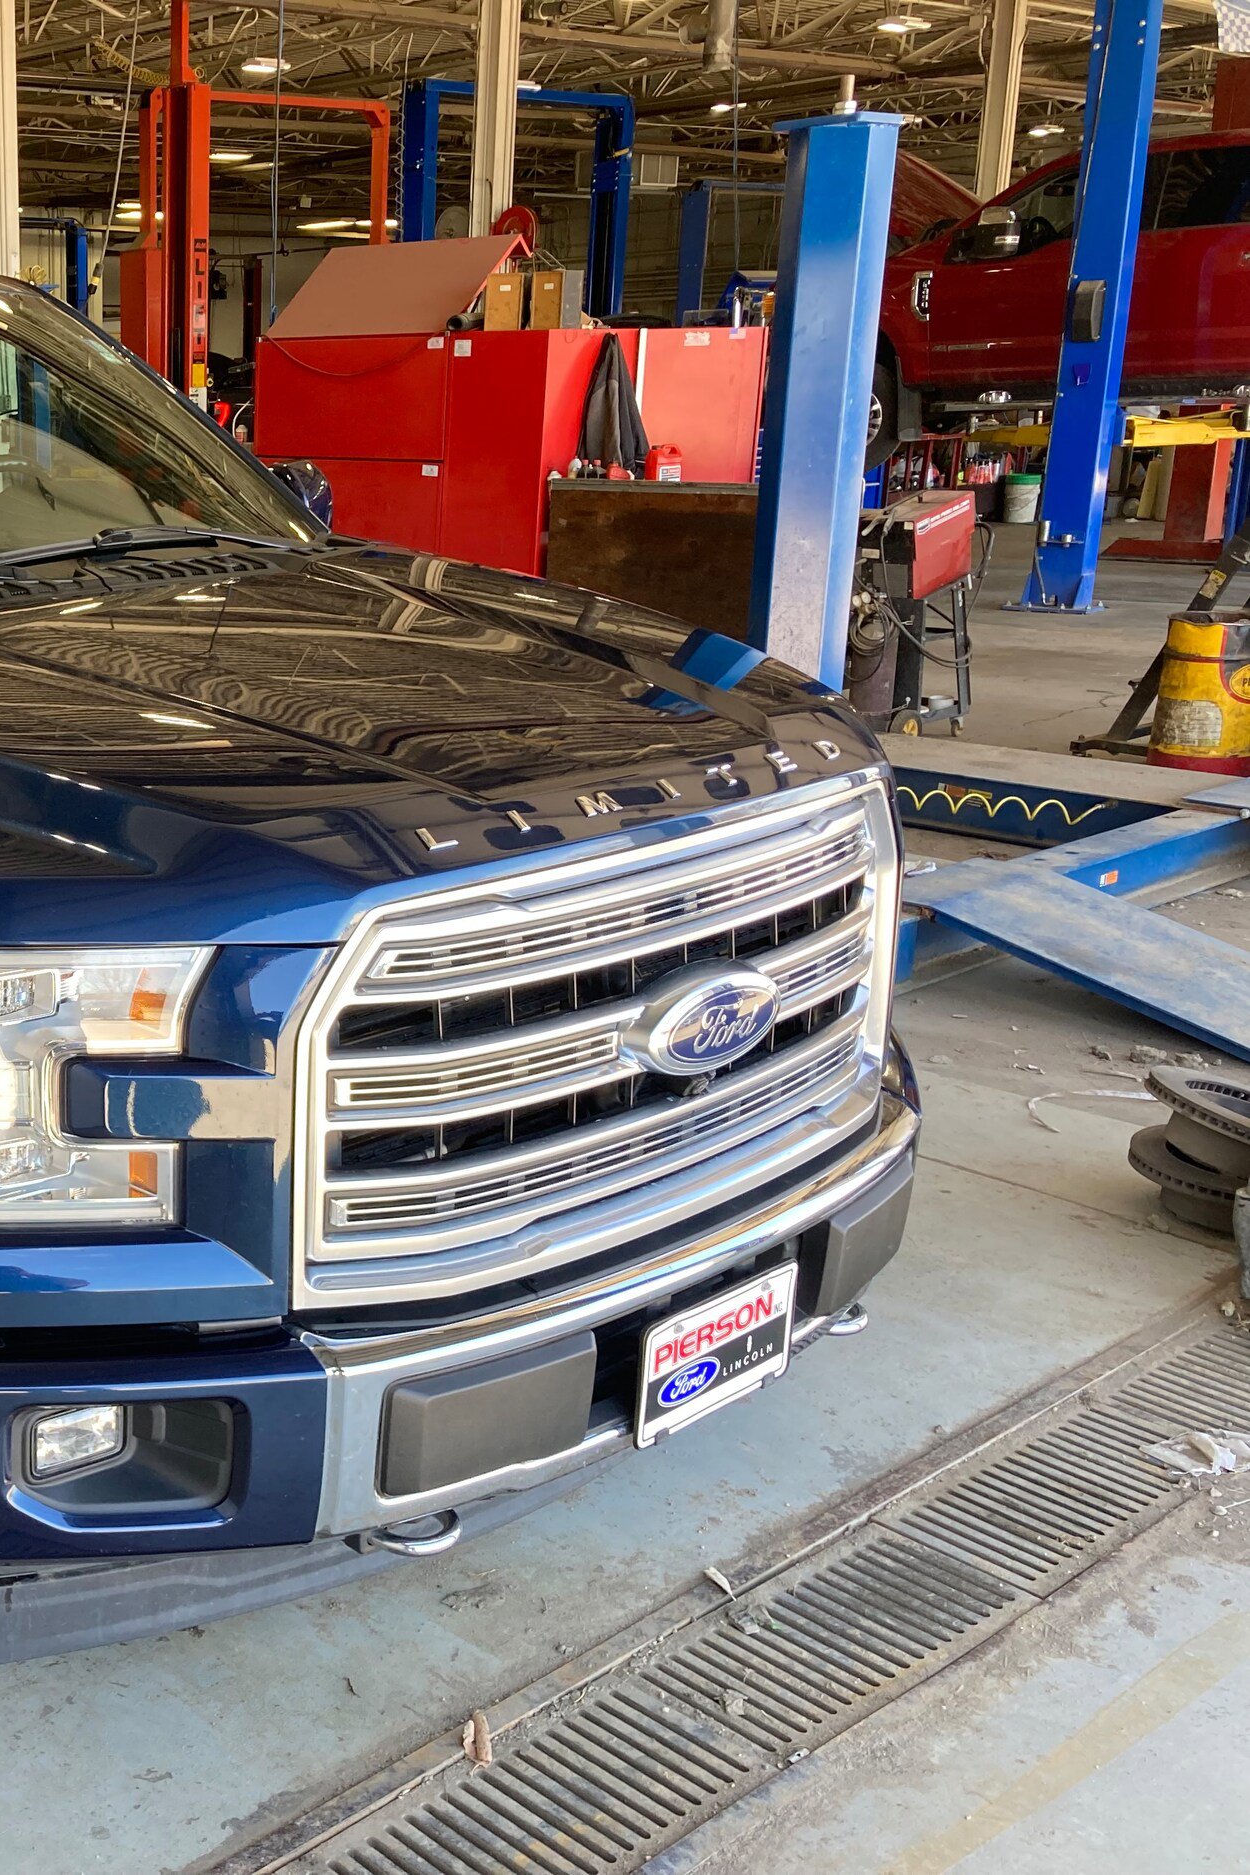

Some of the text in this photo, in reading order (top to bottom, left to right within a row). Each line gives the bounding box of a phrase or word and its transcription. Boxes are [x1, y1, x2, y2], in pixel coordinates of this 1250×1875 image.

[414, 739, 841, 852] LIMITED
[693, 994, 760, 1054] Ford
[652, 1291, 775, 1376] PIERSON
[722, 1342, 774, 1377] LINCOLN
[669, 1365, 707, 1400] Ford
